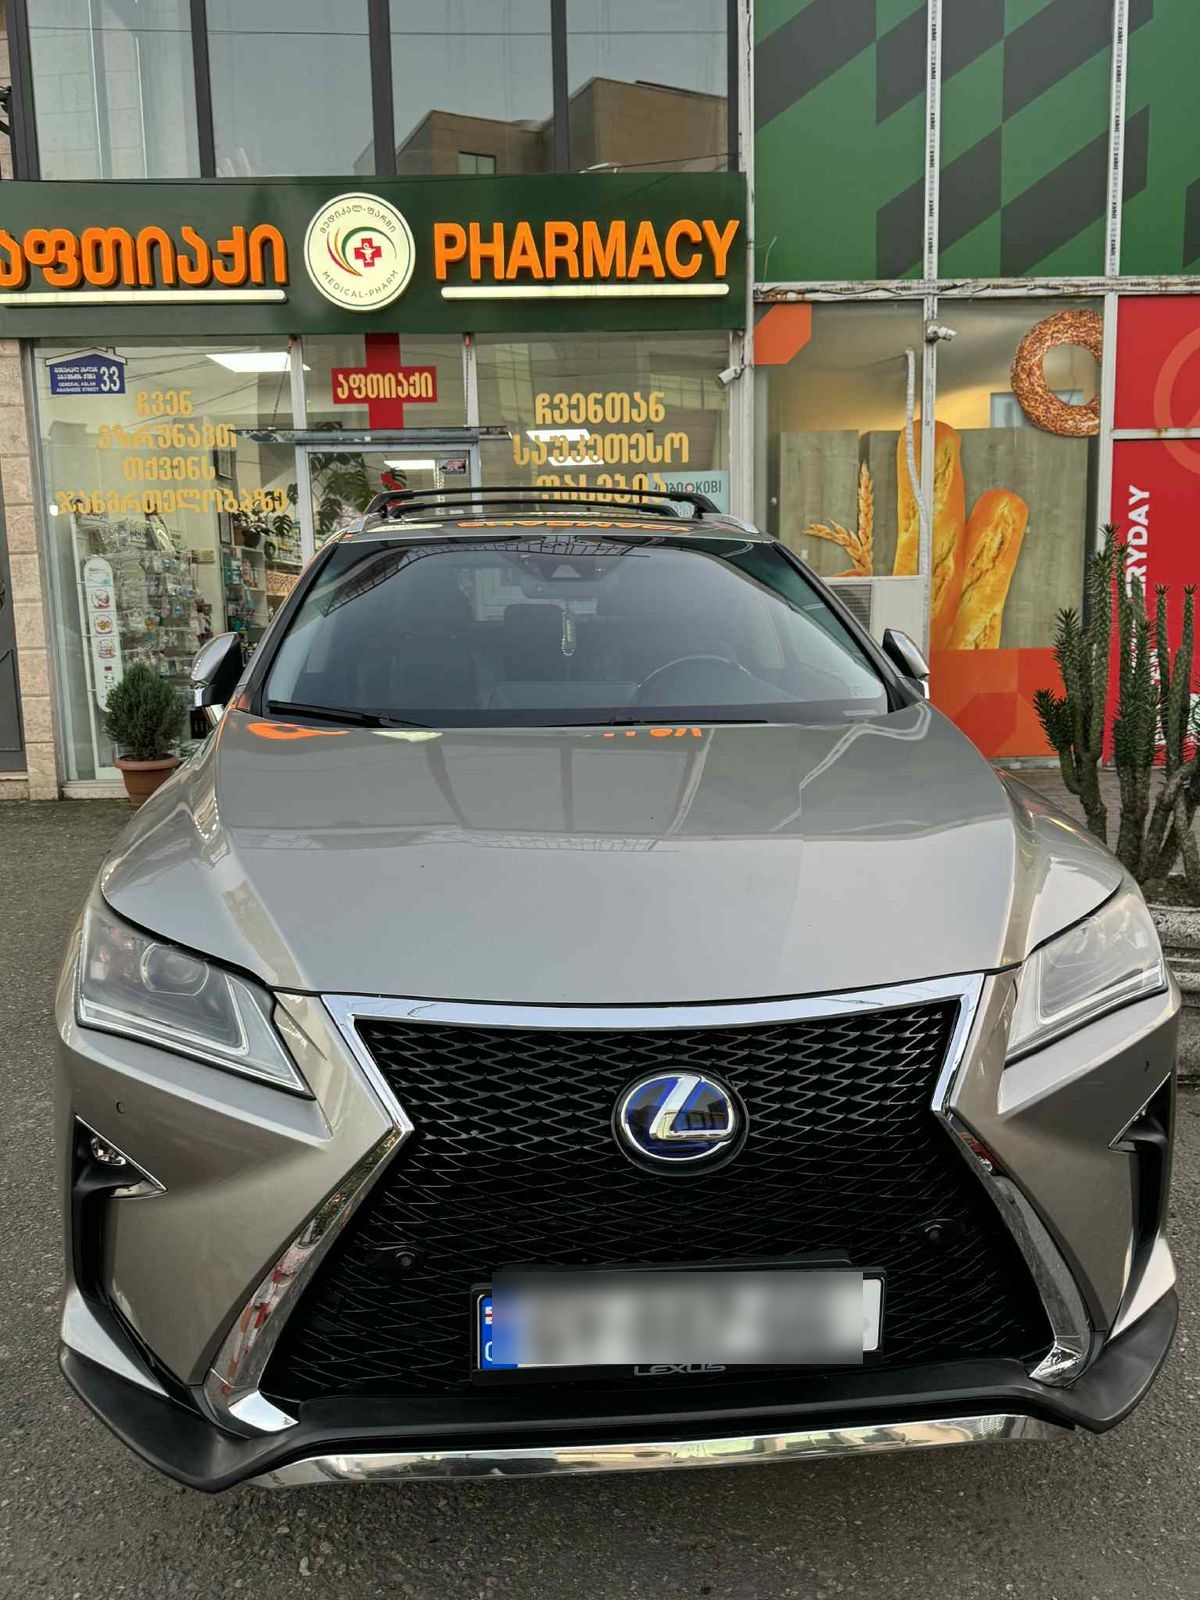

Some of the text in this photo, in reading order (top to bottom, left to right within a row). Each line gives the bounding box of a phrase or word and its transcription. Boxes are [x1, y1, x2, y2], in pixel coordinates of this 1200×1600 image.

[0, 224, 288, 290] აფთიაქი
[433, 219, 740, 281] PHARMACY
[321, 269, 399, 298] MEDICAL-PHARM
[100, 366, 120, 392] 33
[336, 371, 433, 400] აფთიაქი
[136, 390, 193, 417] ჩვენ
[535, 391, 666, 425] ჩვენთან
[512, 431, 689, 466] საუკეთესო
[123, 455, 217, 481] თქვენს
[696, 480, 722, 494] KOBI
[633, 1363, 726, 1376] LEXUS
